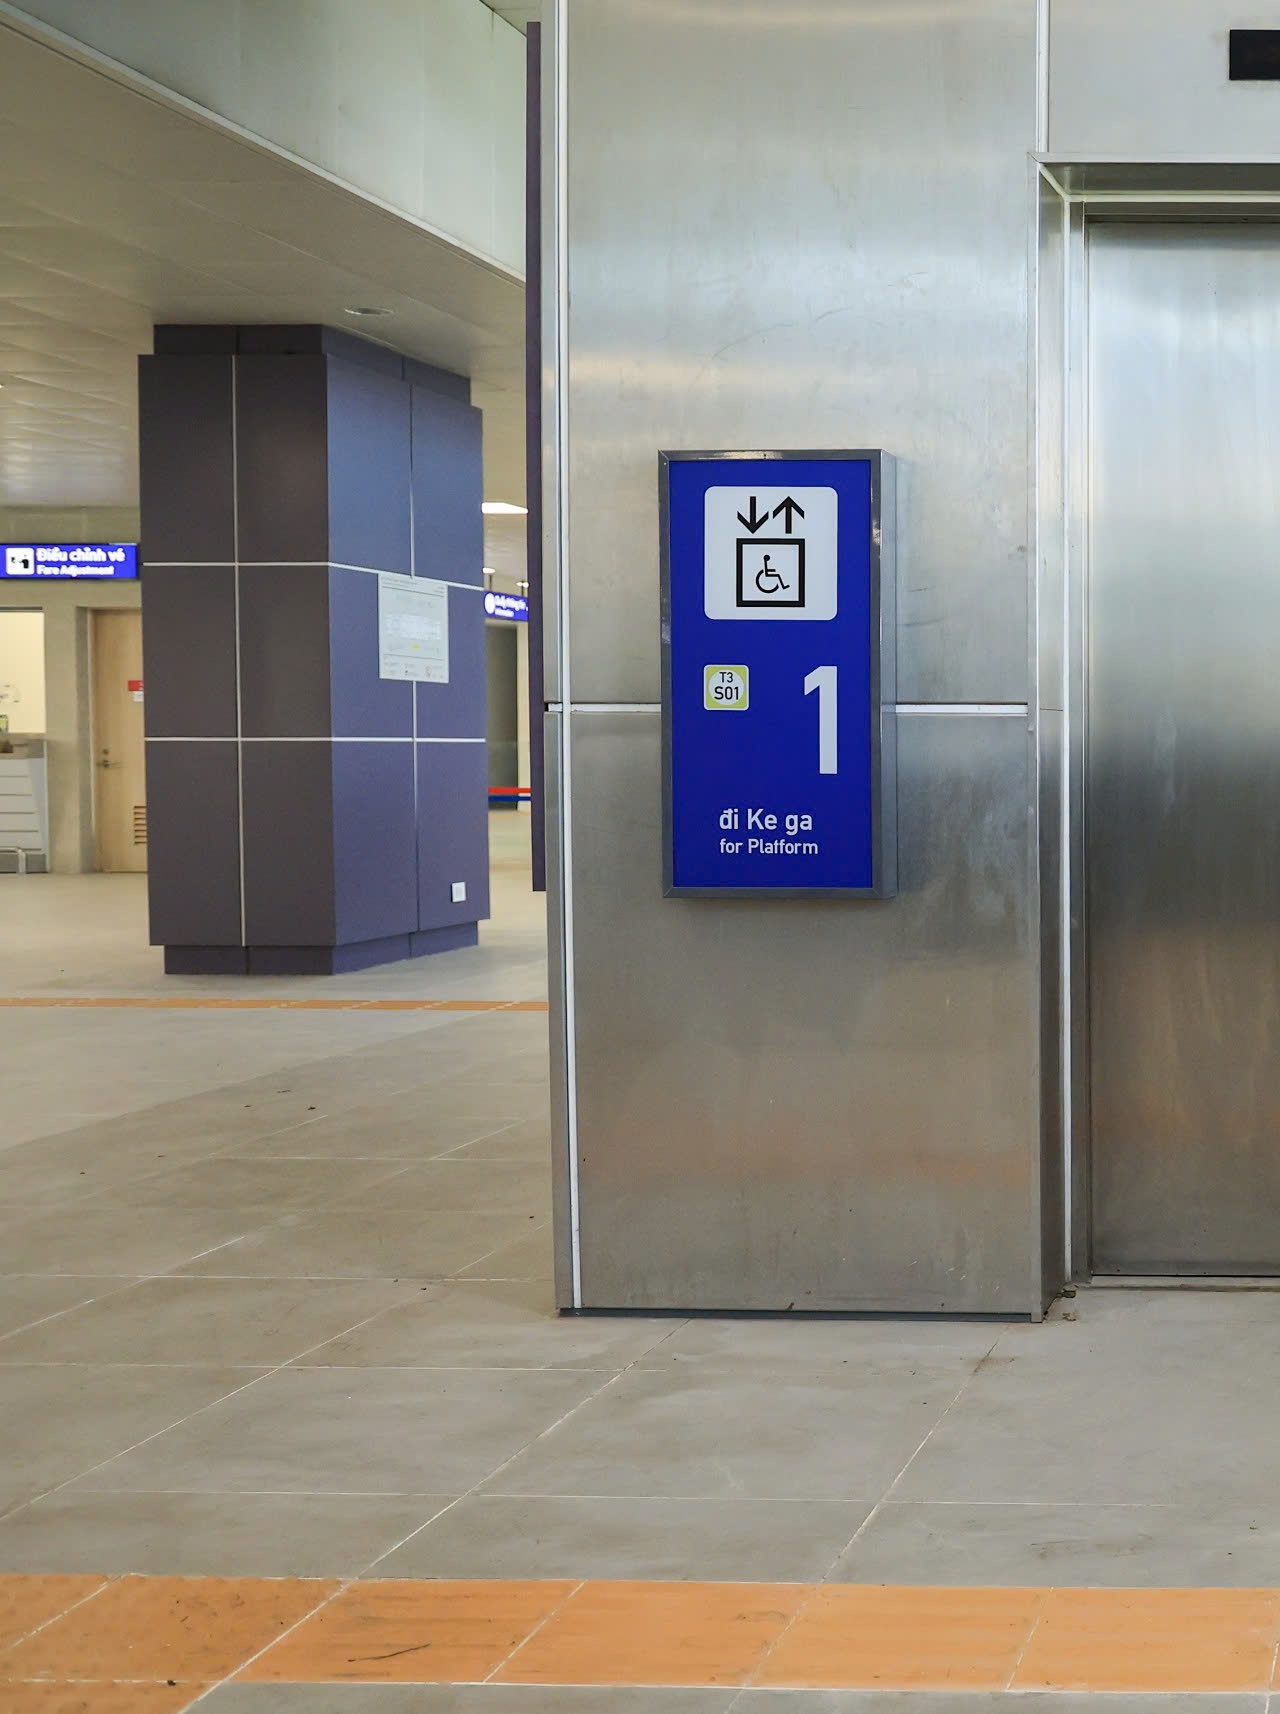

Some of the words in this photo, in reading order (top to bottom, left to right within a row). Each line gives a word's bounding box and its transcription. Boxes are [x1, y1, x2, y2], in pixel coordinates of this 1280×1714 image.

[37, 547, 68, 561] Điều
[69, 547, 107, 561] chỉnh
[107, 548, 125, 561] vé
[37, 565, 60, 575] Fare
[60, 565, 114, 577] Adjustment
[719, 671, 734, 683] T3
[714, 685, 739, 700] S01
[804, 665, 838, 775] 1
[719, 808, 739, 830] đi
[747, 808, 778, 830] Ke
[785, 813, 813, 836] ga
[719, 838, 743, 854] for
[748, 838, 819, 855] Platform
